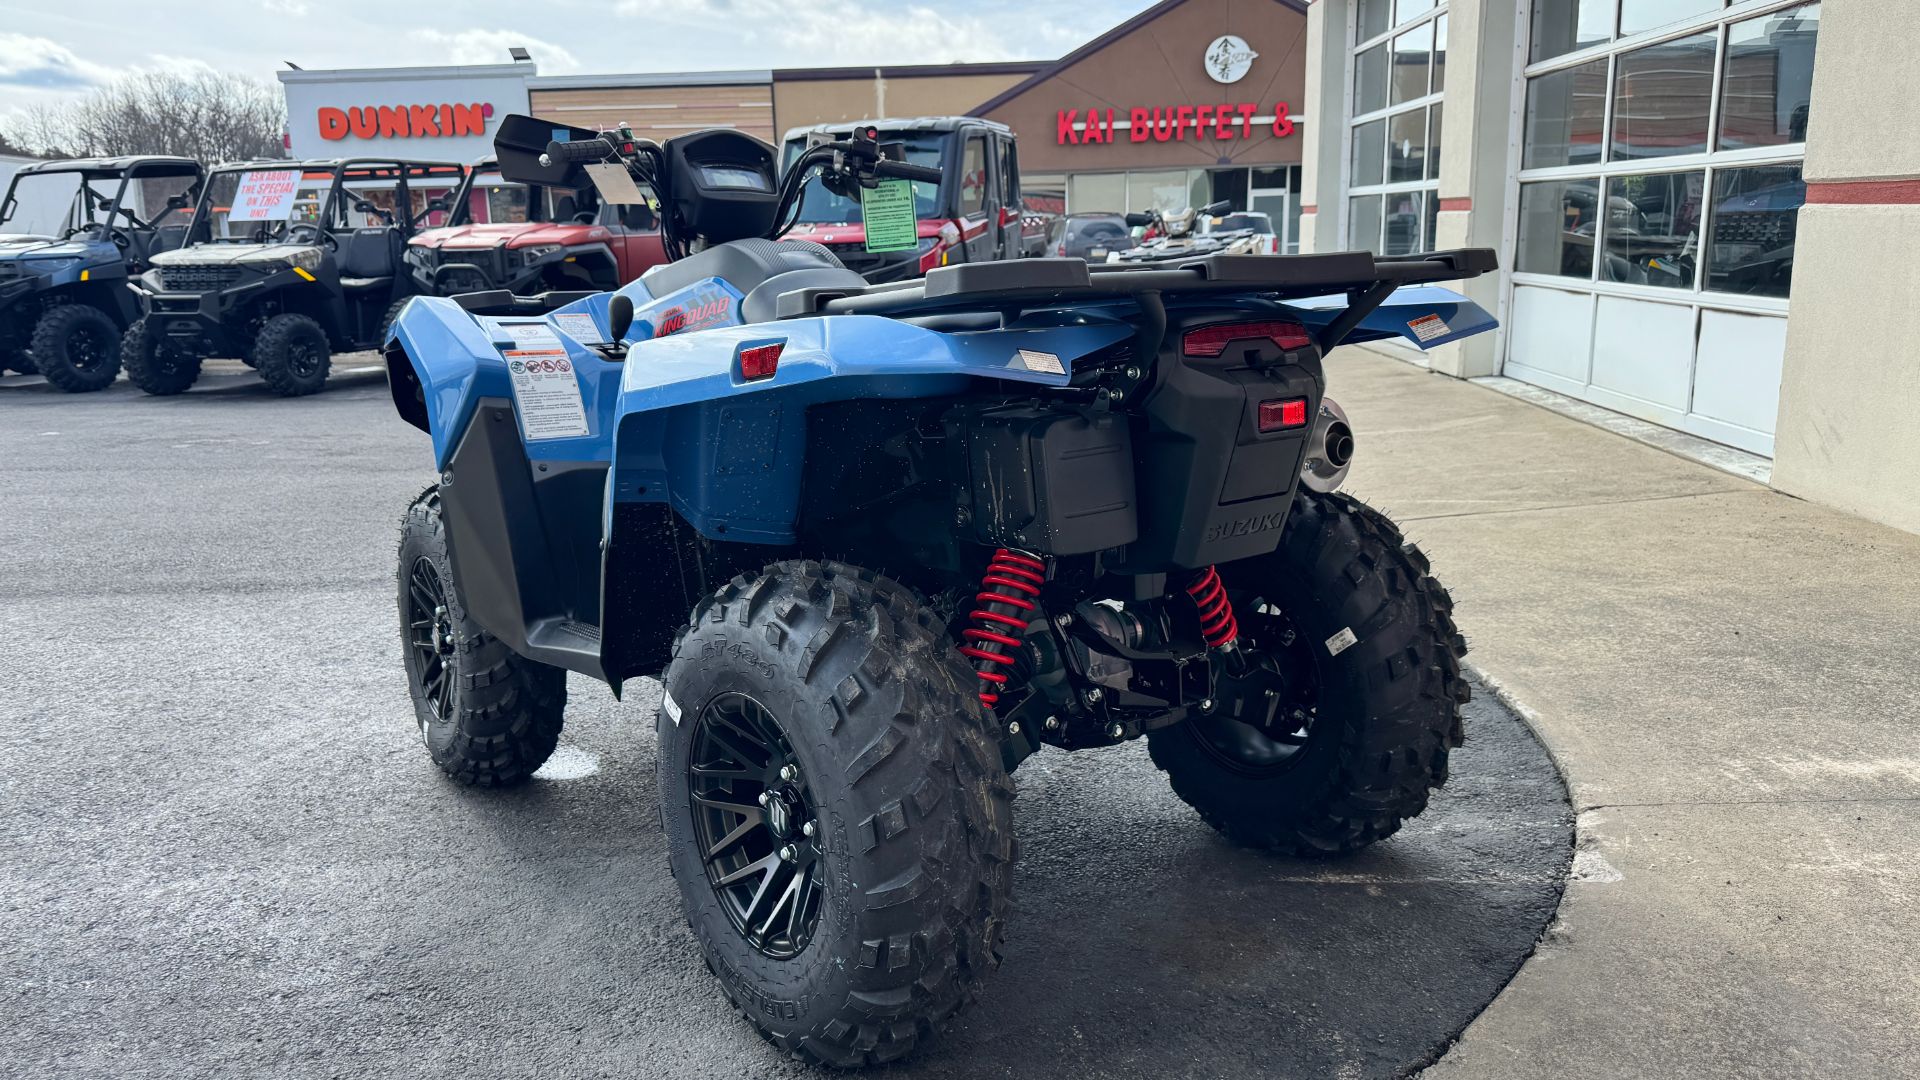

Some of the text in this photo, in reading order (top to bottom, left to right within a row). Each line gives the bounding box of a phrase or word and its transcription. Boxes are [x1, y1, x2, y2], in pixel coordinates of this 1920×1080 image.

[317, 102, 494, 141] DUNKIN'
[1057, 101, 1295, 145] KAI BUFFET &
[249, 171, 292, 182] ASK ABOUT
[241, 182, 295, 194] THE SPECIAL
[246, 194, 283, 206] ON THIS
[249, 208, 270, 218] UNIT
[170, 273, 218, 282] POLARIS
[655, 296, 731, 338] KINGQUAD
[1206, 511, 1286, 543] SUZUKI
